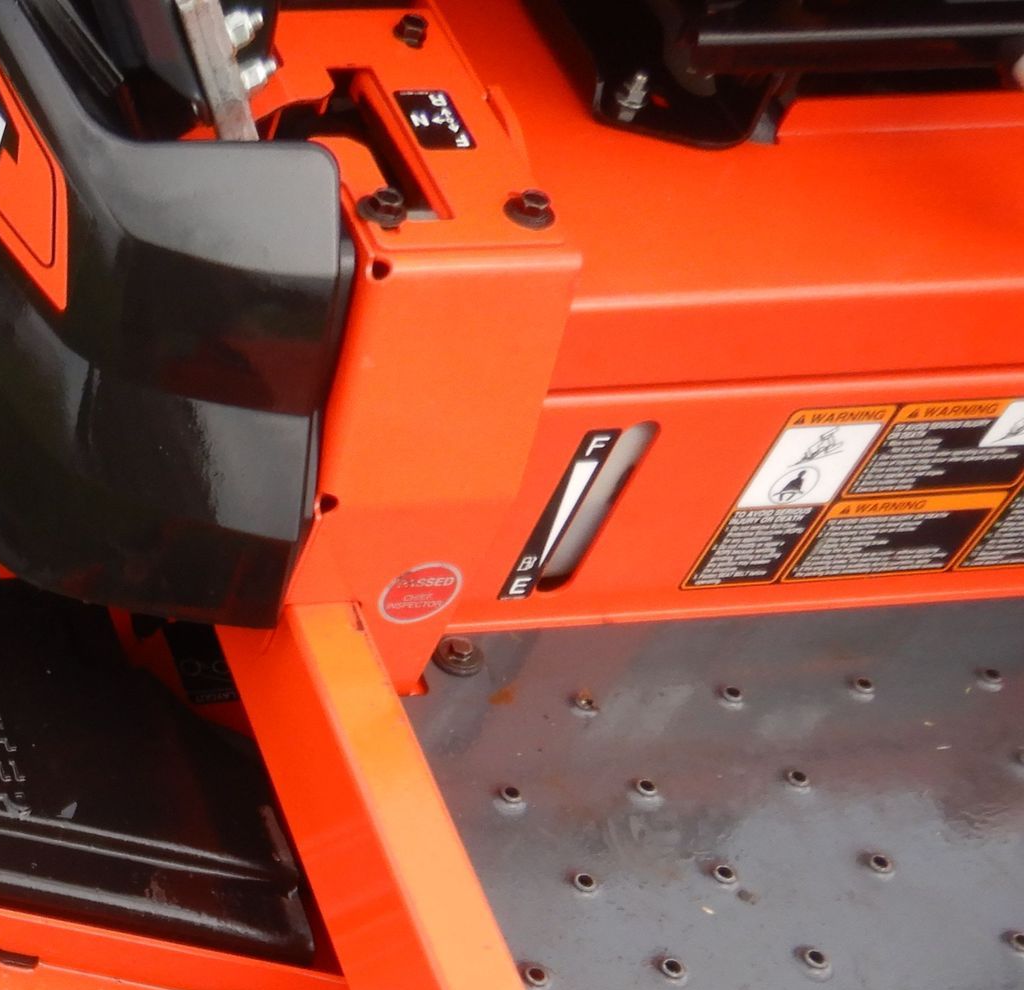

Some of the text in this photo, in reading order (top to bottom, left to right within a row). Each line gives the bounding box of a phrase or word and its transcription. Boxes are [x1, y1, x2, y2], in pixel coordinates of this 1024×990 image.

[811, 409, 885, 424] WARNING
[926, 402, 999, 417] WARNING
[585, 436, 611, 457] F
[747, 509, 774, 517] AVOID
[774, 507, 813, 516] SERIOUS
[855, 500, 927, 513] WARNING
[728, 515, 805, 525] INJURY OR DEATH
[509, 577, 532, 595] E
